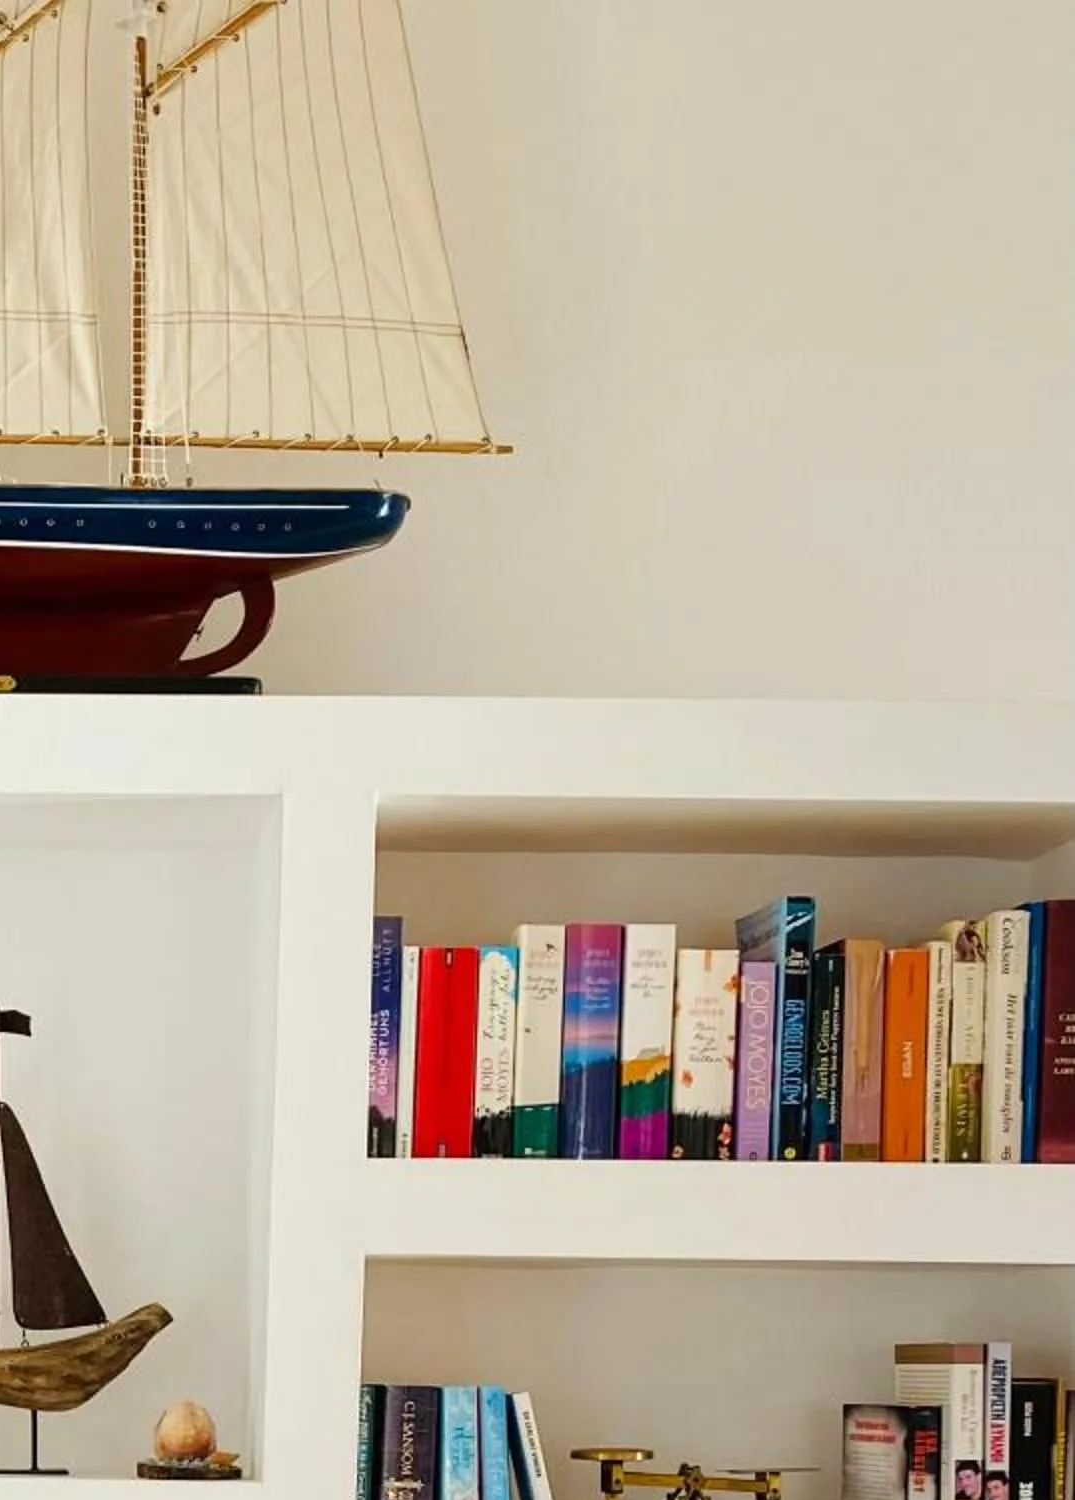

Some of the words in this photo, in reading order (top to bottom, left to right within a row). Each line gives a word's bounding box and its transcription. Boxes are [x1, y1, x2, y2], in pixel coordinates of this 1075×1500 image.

[1000, 917, 1015, 975] Cookson
[379, 1009, 390, 1042] UNS
[745, 979, 771, 1030] JOJO
[816, 1009, 830, 1053] Grimes
[480, 1057, 494, 1092] JOJO
[495, 1048, 510, 1104] MOYES
[744, 1033, 768, 1111] MOYES
[815, 1056, 829, 1100] Martha
[400, 1421, 414, 1475] SANSOM
